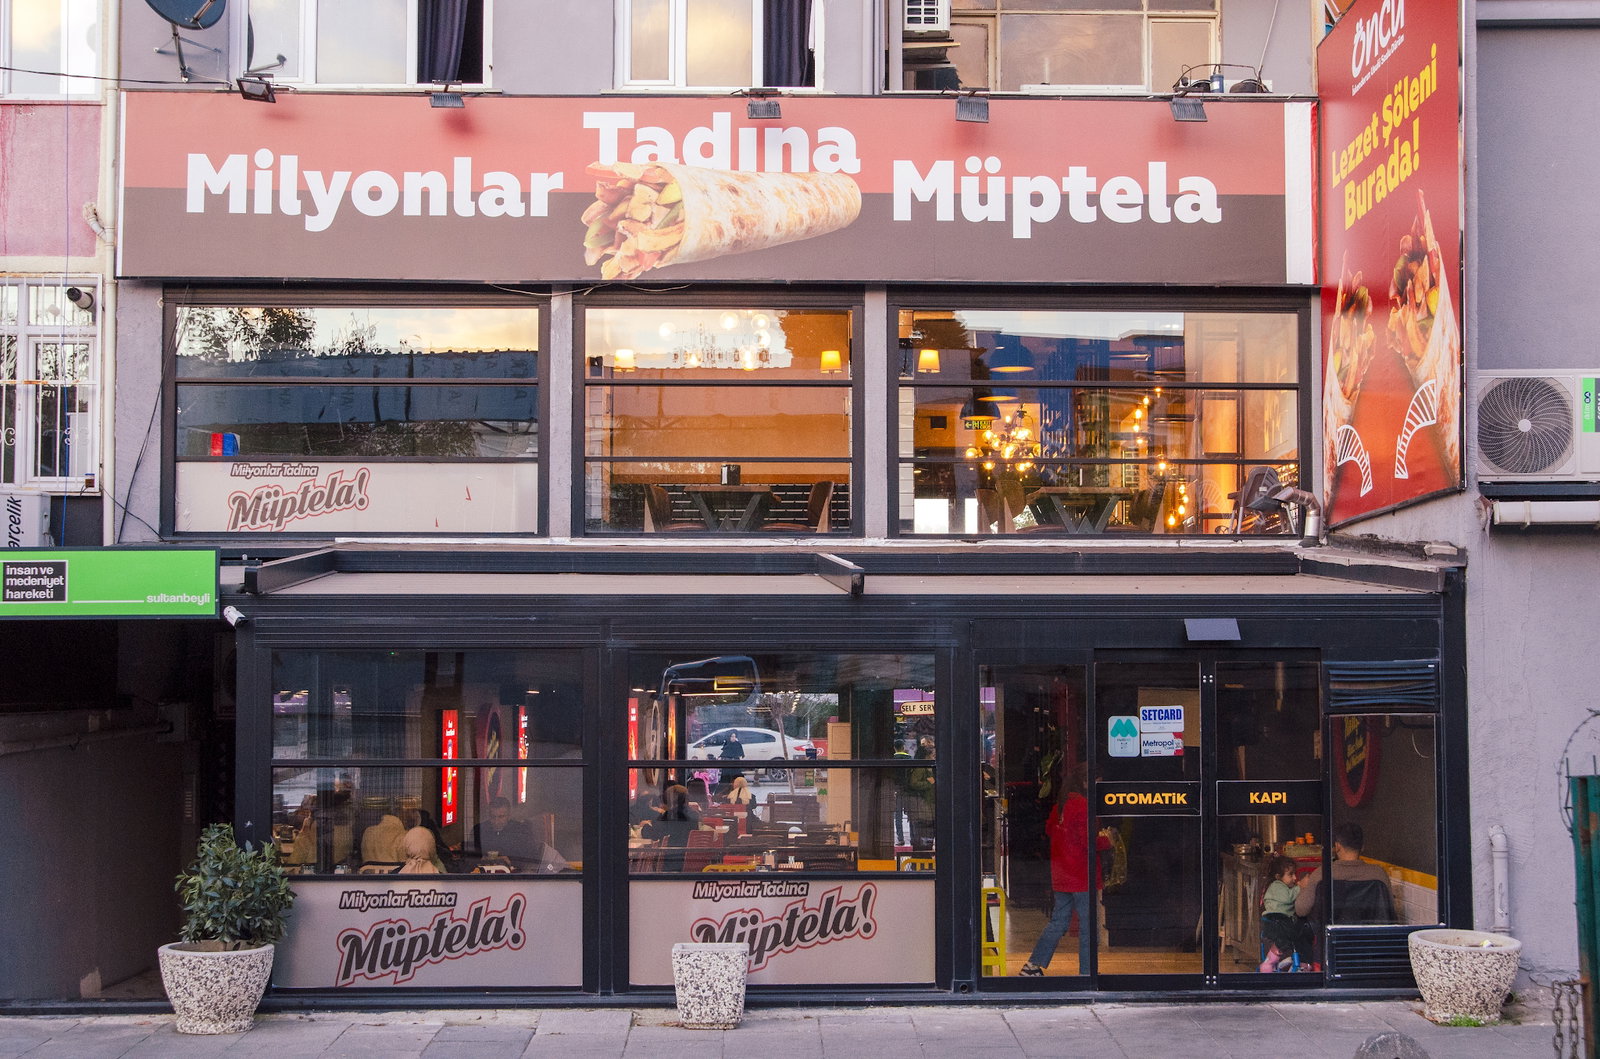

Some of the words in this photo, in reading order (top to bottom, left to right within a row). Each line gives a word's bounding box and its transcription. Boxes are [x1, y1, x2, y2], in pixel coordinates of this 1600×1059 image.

[1332, 111, 1378, 189] Lezzet
[1382, 42, 1437, 148] Şöleni
[186, 148, 564, 232] Milyonlar
[583, 111, 861, 174] Tadına
[892, 155, 1222, 239] Müptela
[1344, 117, 1420, 231] Burada!
[231, 463, 281, 479] Milyonlar
[282, 463, 319, 477] Tadına
[229, 469, 369, 531] Müptela!
[6, 565, 38, 575] insan
[39, 566, 54, 575] ve
[6, 575, 65, 589] medeniyet
[6, 588, 54, 599] hareketi
[146, 593, 211, 606] sultanbeyli
[901, 704, 916, 713] SELF
[1141, 708, 1183, 721] SETCARD
[1142, 739, 1174, 749] Metropol
[1249, 792, 1287, 804] KAPI
[692, 881, 762, 902] Milyonlar
[762, 881, 810, 898] Tadına
[339, 889, 407, 912] Milyonlar
[408, 889, 458, 907] Tadına
[339, 897, 524, 983] Müptela!
